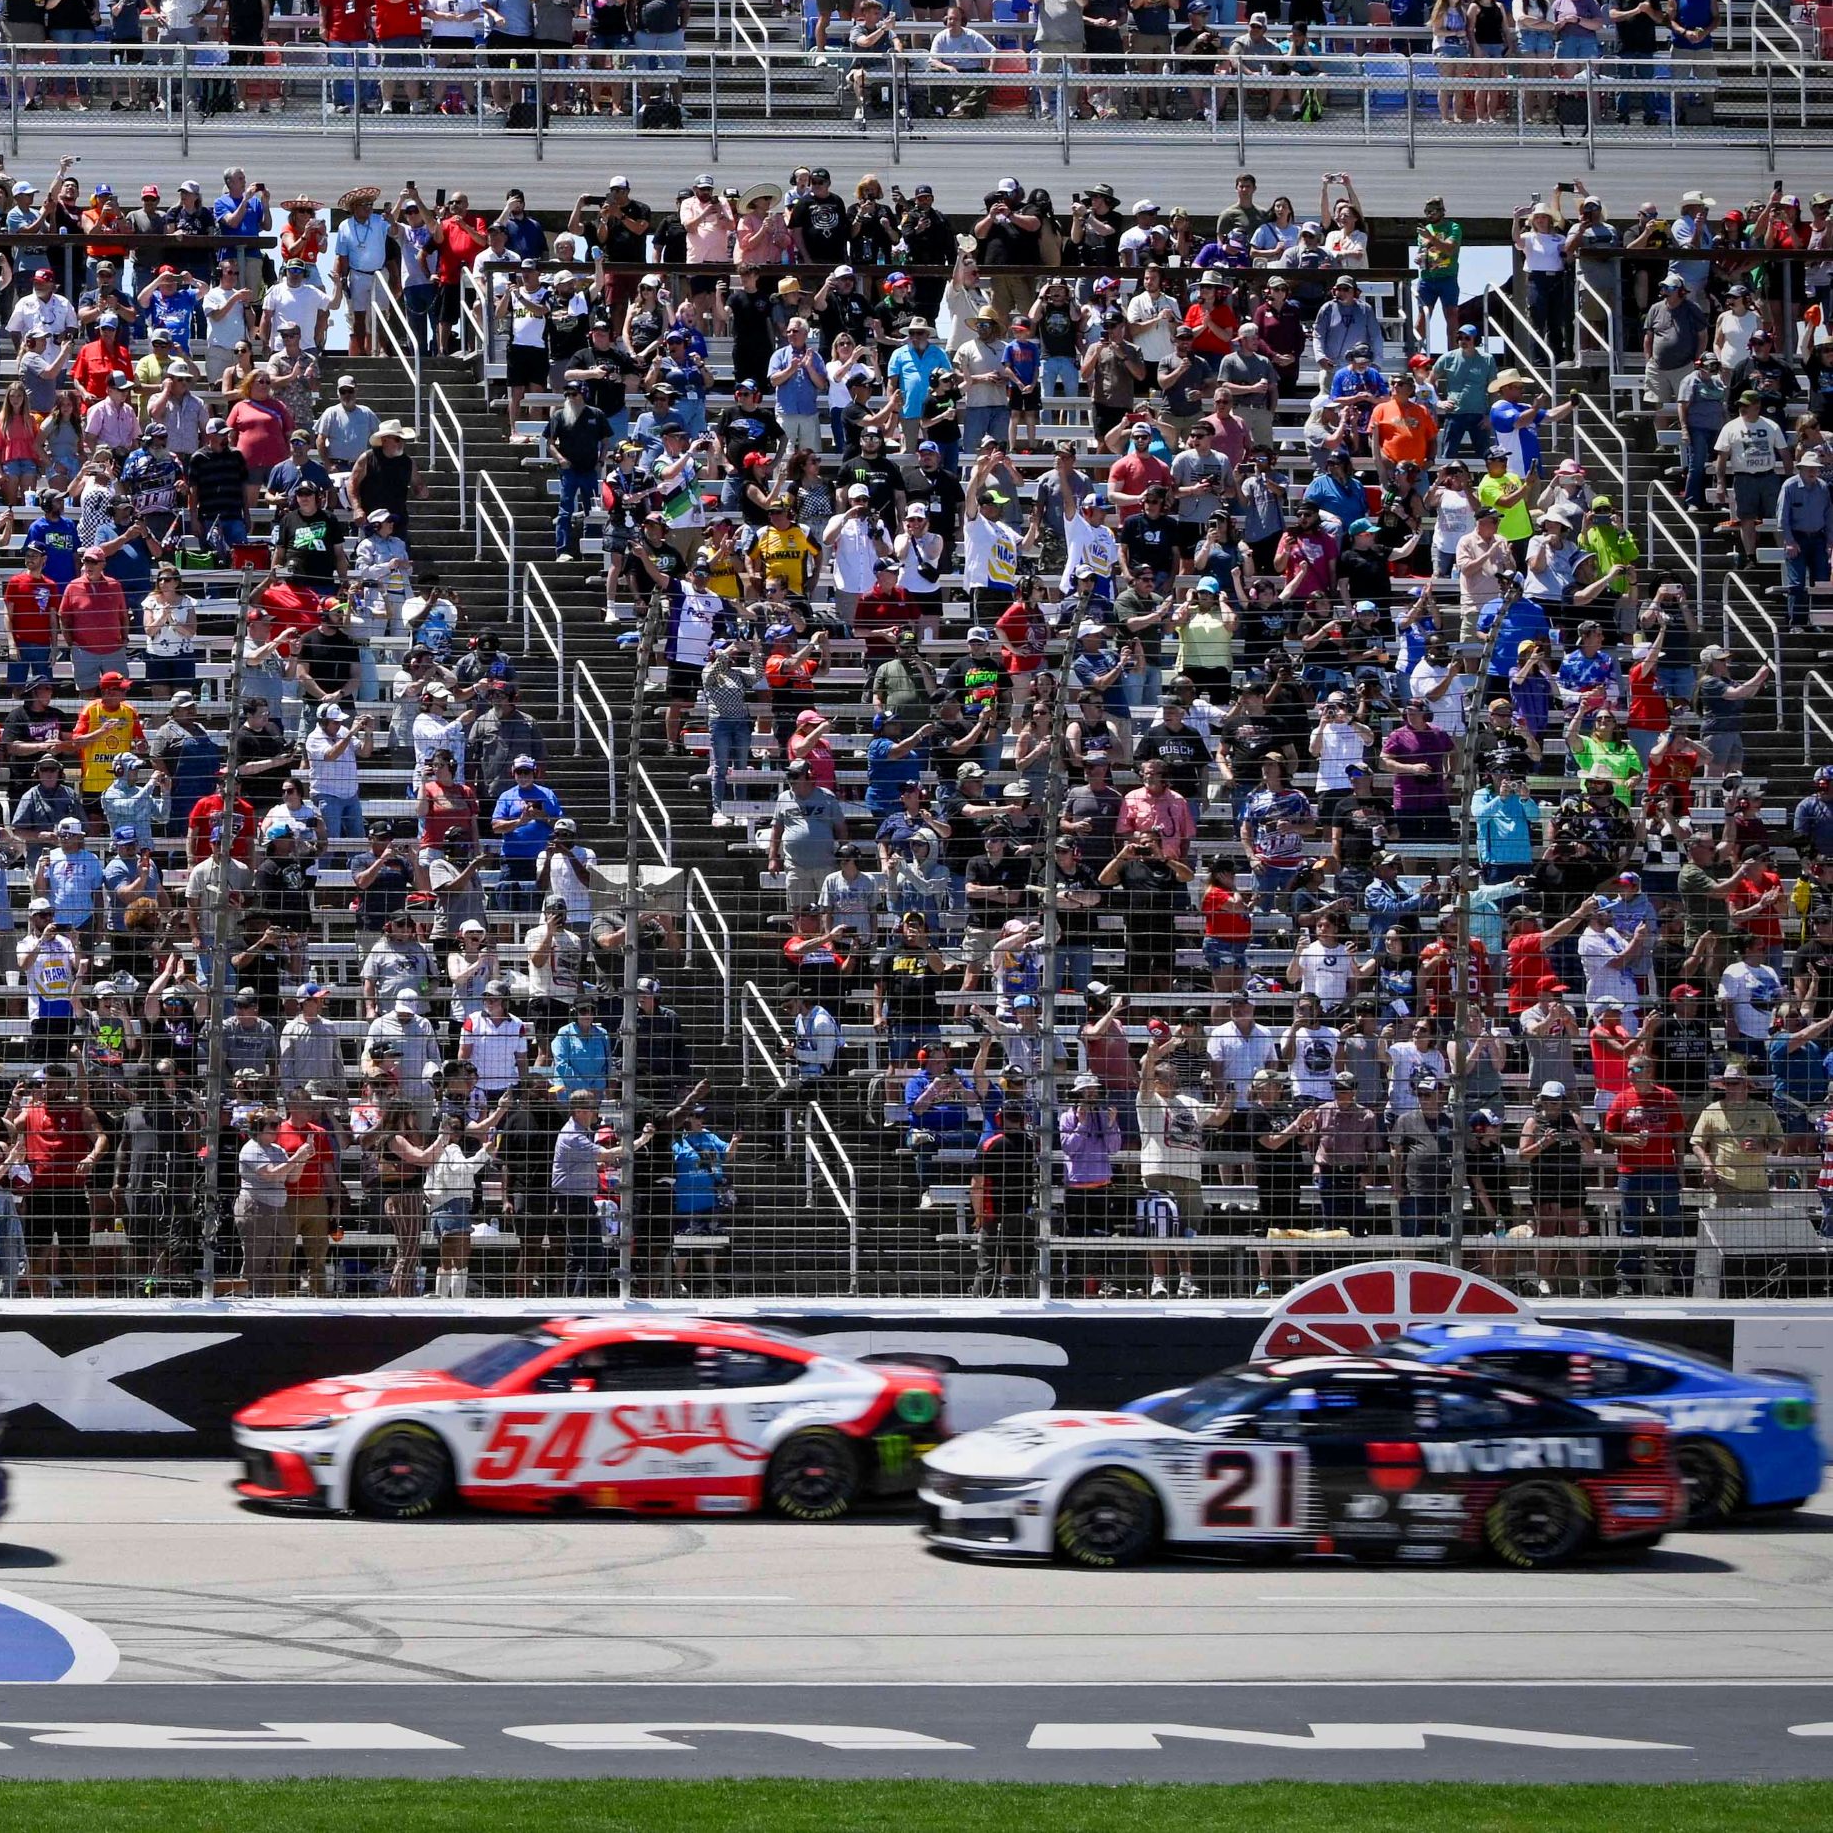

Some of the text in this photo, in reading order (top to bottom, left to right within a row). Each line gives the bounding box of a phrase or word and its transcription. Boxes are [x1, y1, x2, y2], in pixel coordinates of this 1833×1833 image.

[1741, 428, 1766, 439] H-D
[657, 557, 669, 567] 20
[46, 728, 60, 741] 48
[1159, 744, 1193, 755] BUSCH
[94, 753, 114, 762] PENN
[44, 965, 67, 983] NAPA
[475, 1411, 594, 1483] 54
[1204, 1450, 1296, 1528] 21
